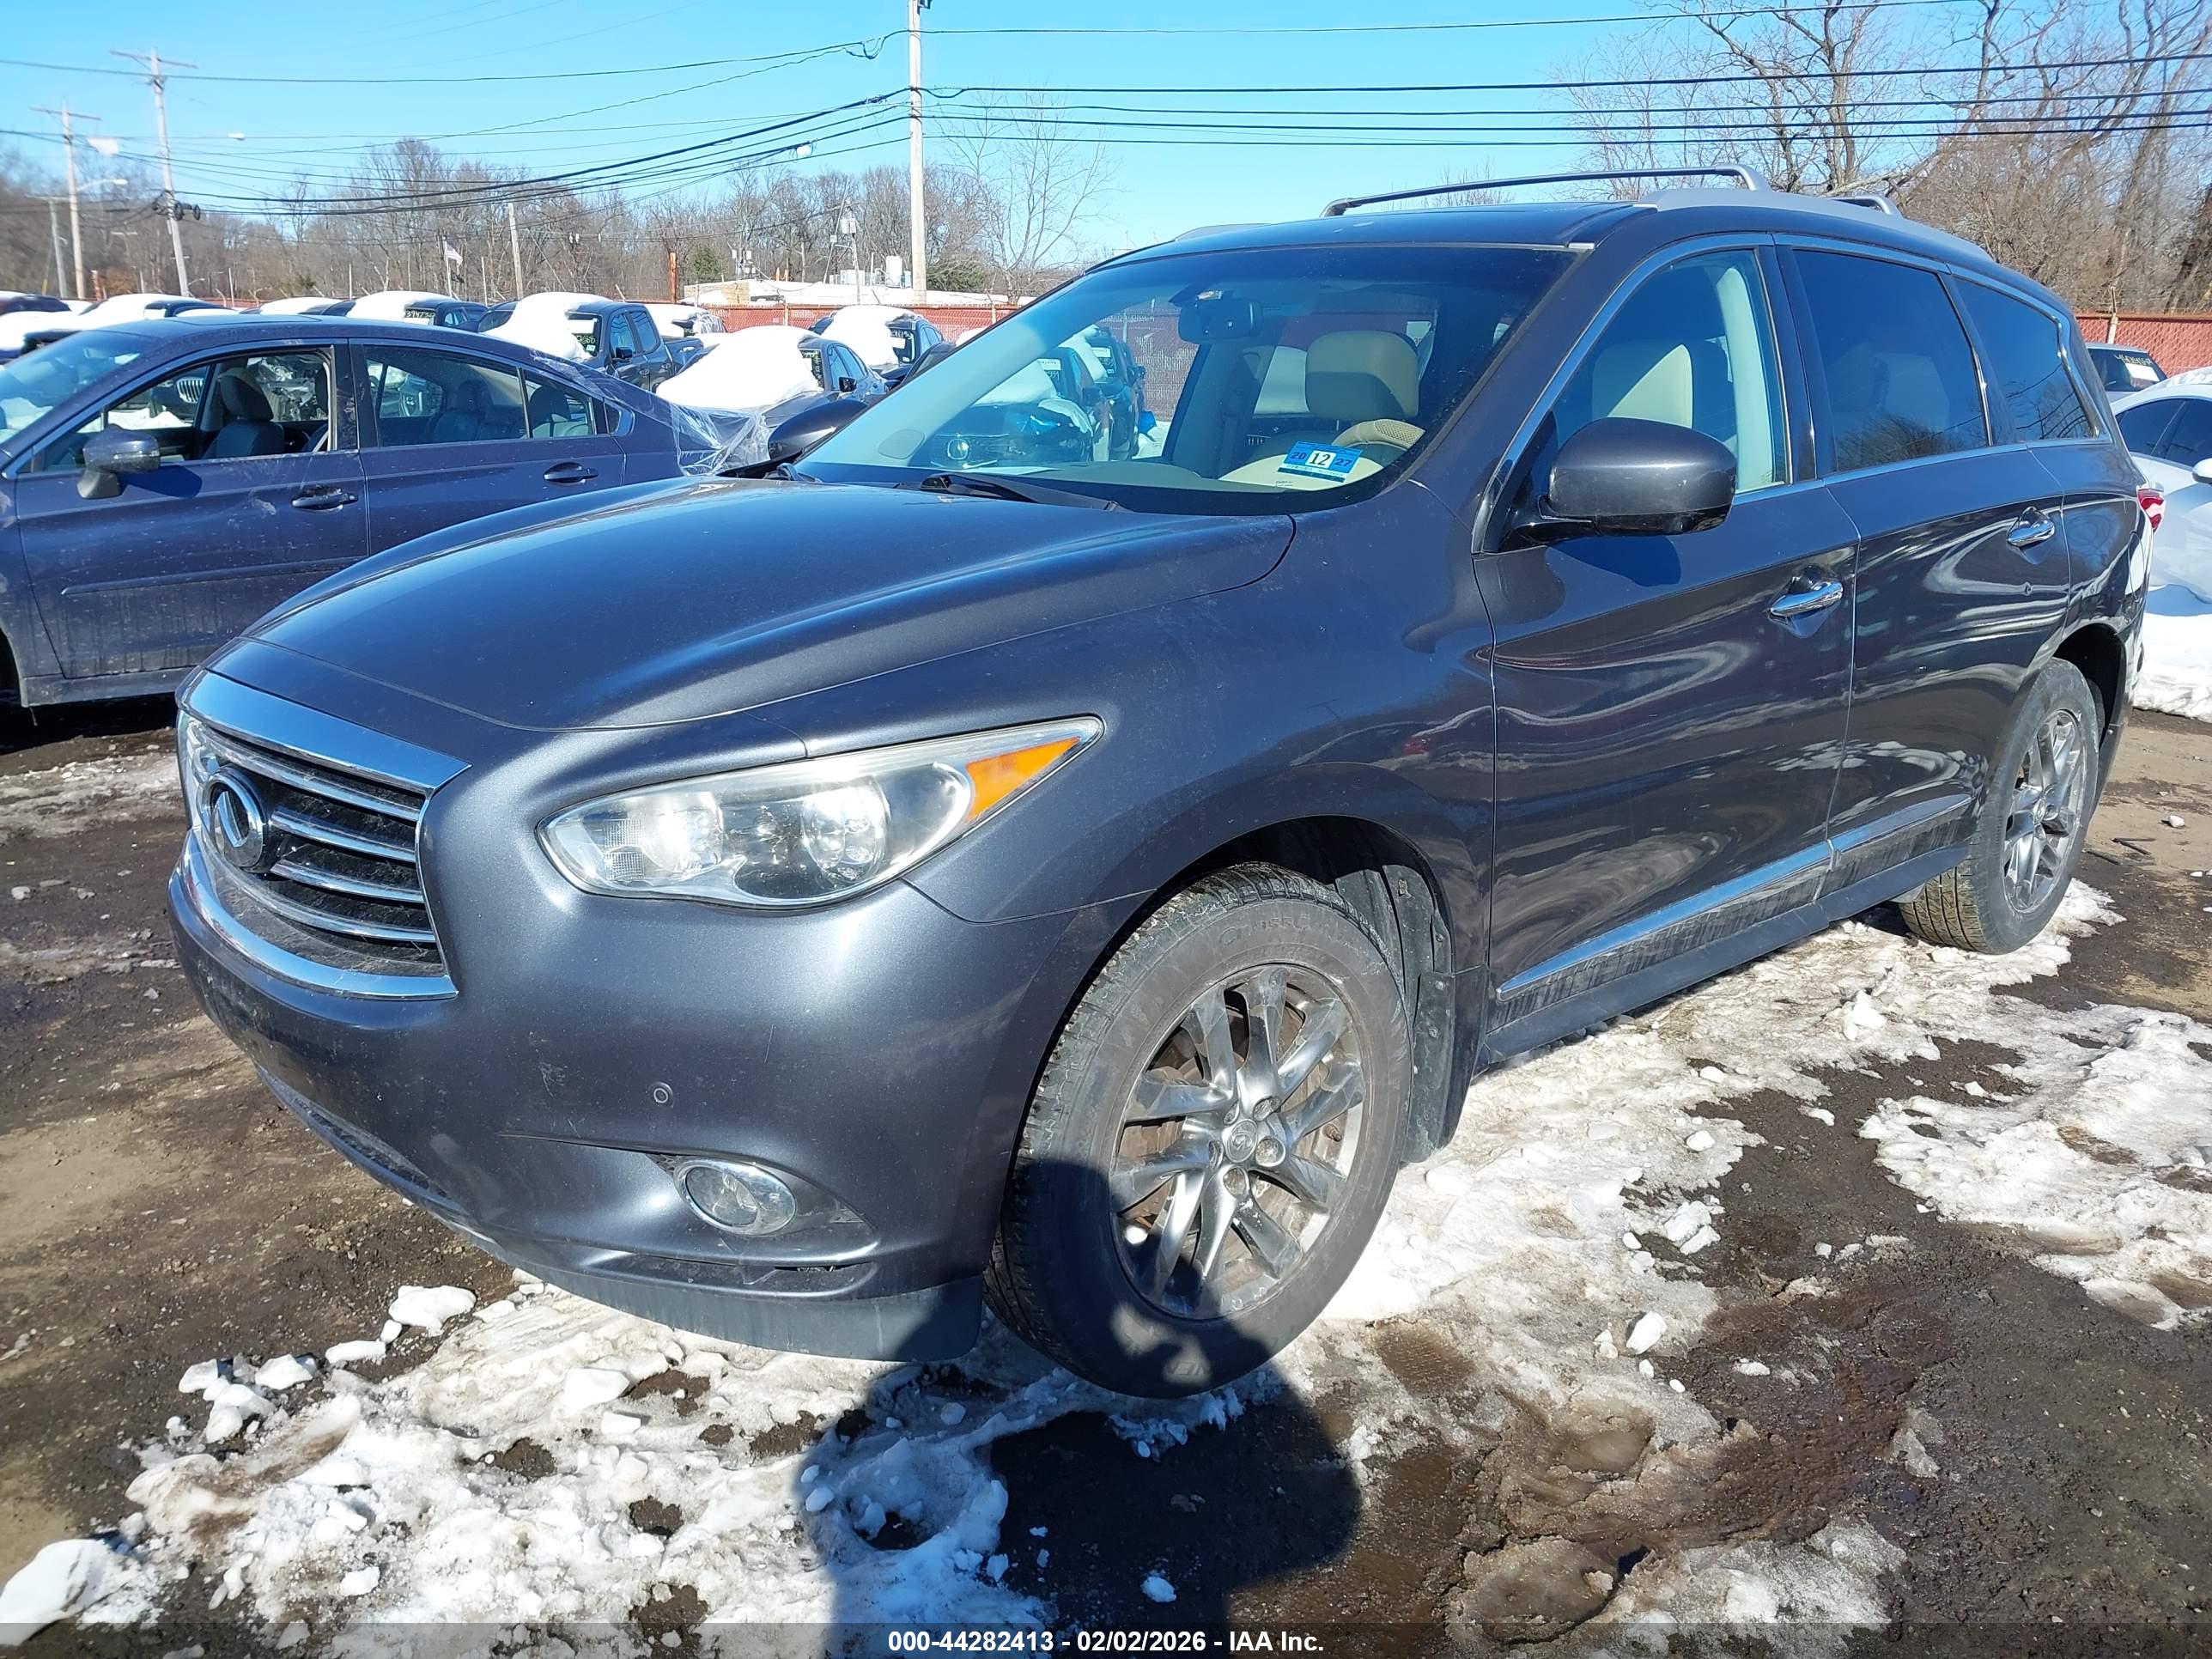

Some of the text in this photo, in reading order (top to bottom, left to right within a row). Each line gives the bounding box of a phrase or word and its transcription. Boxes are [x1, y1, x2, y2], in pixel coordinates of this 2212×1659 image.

[1291, 451, 1353, 467] 20 12 27
